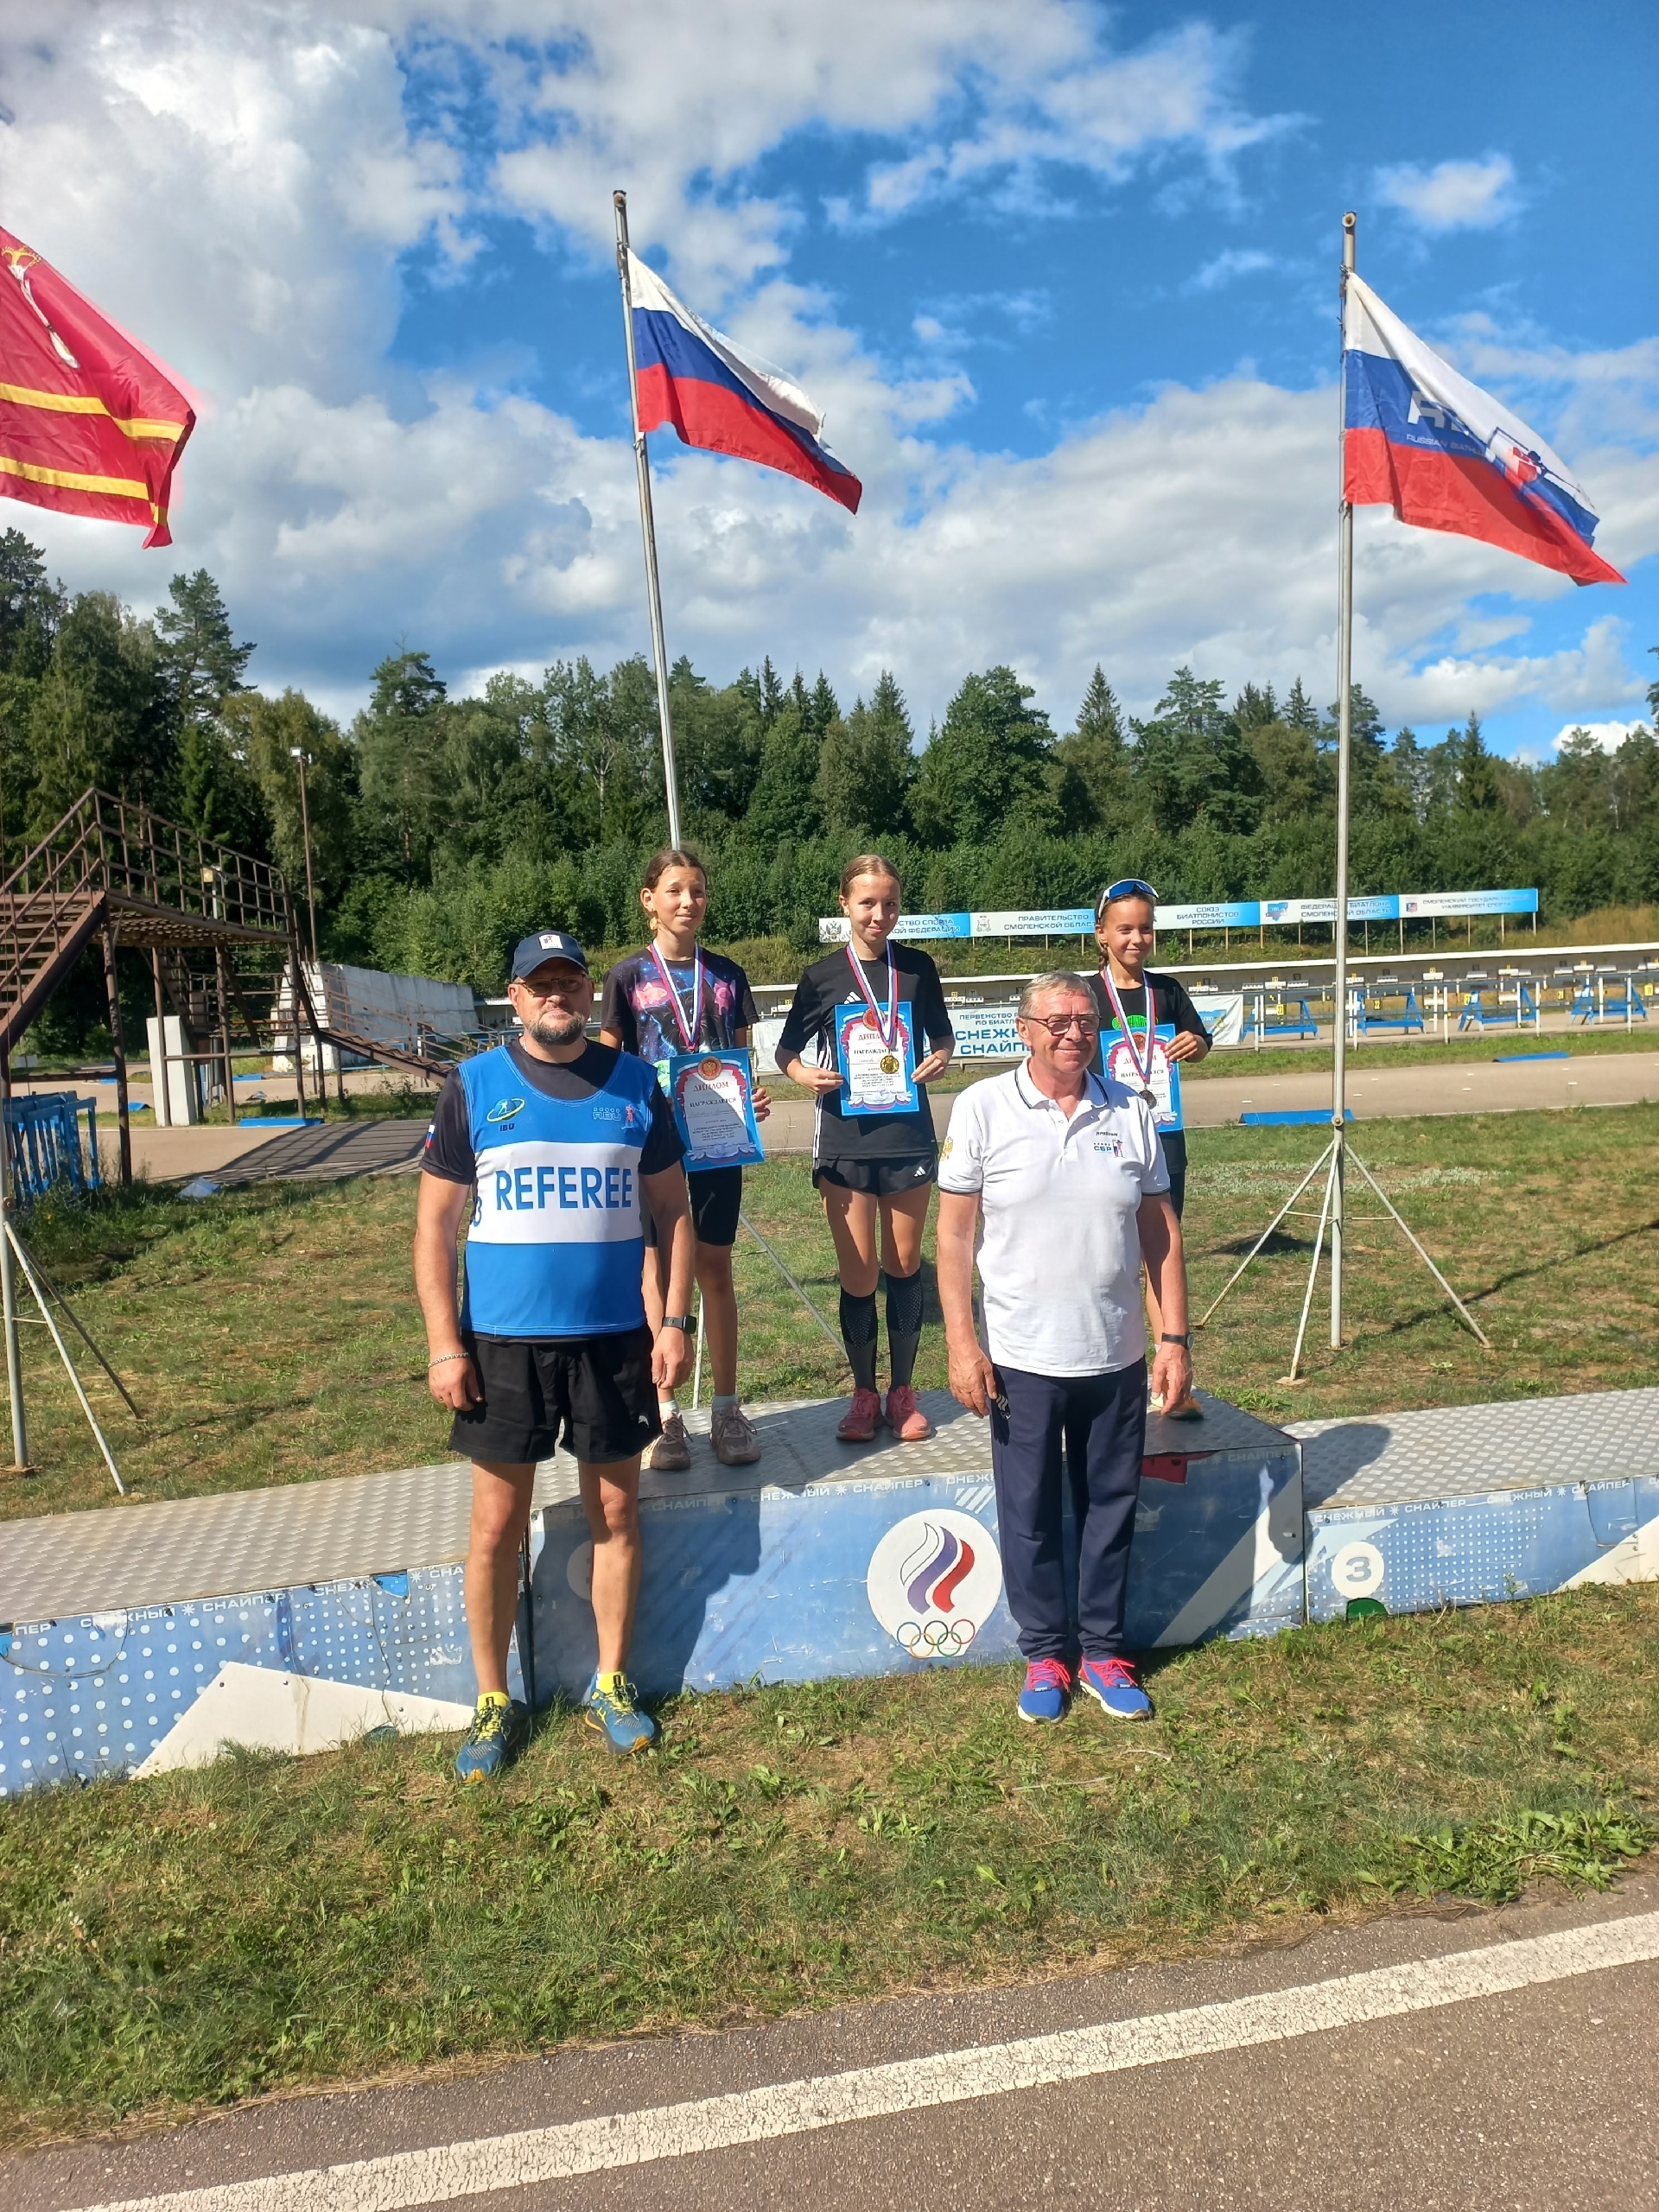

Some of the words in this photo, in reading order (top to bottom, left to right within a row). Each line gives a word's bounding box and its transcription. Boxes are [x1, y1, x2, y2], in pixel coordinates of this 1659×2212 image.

[1406, 434, 1447, 447] RUSSIAN
[1176, 912, 1239, 920] БИАТЛОНИСТОВ
[1003, 922, 1063, 931] СМОЛЕНСКОЙ
[693, 1081, 729, 1092] ДИПЛОМ
[690, 1097, 736, 1108] НАГРАЖДАЕТСЯ
[593, 1111, 621, 1122] RBU
[499, 1122, 515, 1132] IBU
[495, 1166, 632, 1211] REFEREE
[853, 1478, 923, 1493] СНАЙПЕР
[1486, 1487, 1553, 1504] СНЕЖНЫЙ
[1572, 1480, 1631, 1494] САЙПЕР
[1314, 1507, 1385, 1523] СНЕЖНЫЙ
[1404, 1498, 1466, 1513] СНАЙПЕР
[1345, 1556, 1372, 1582] 3
